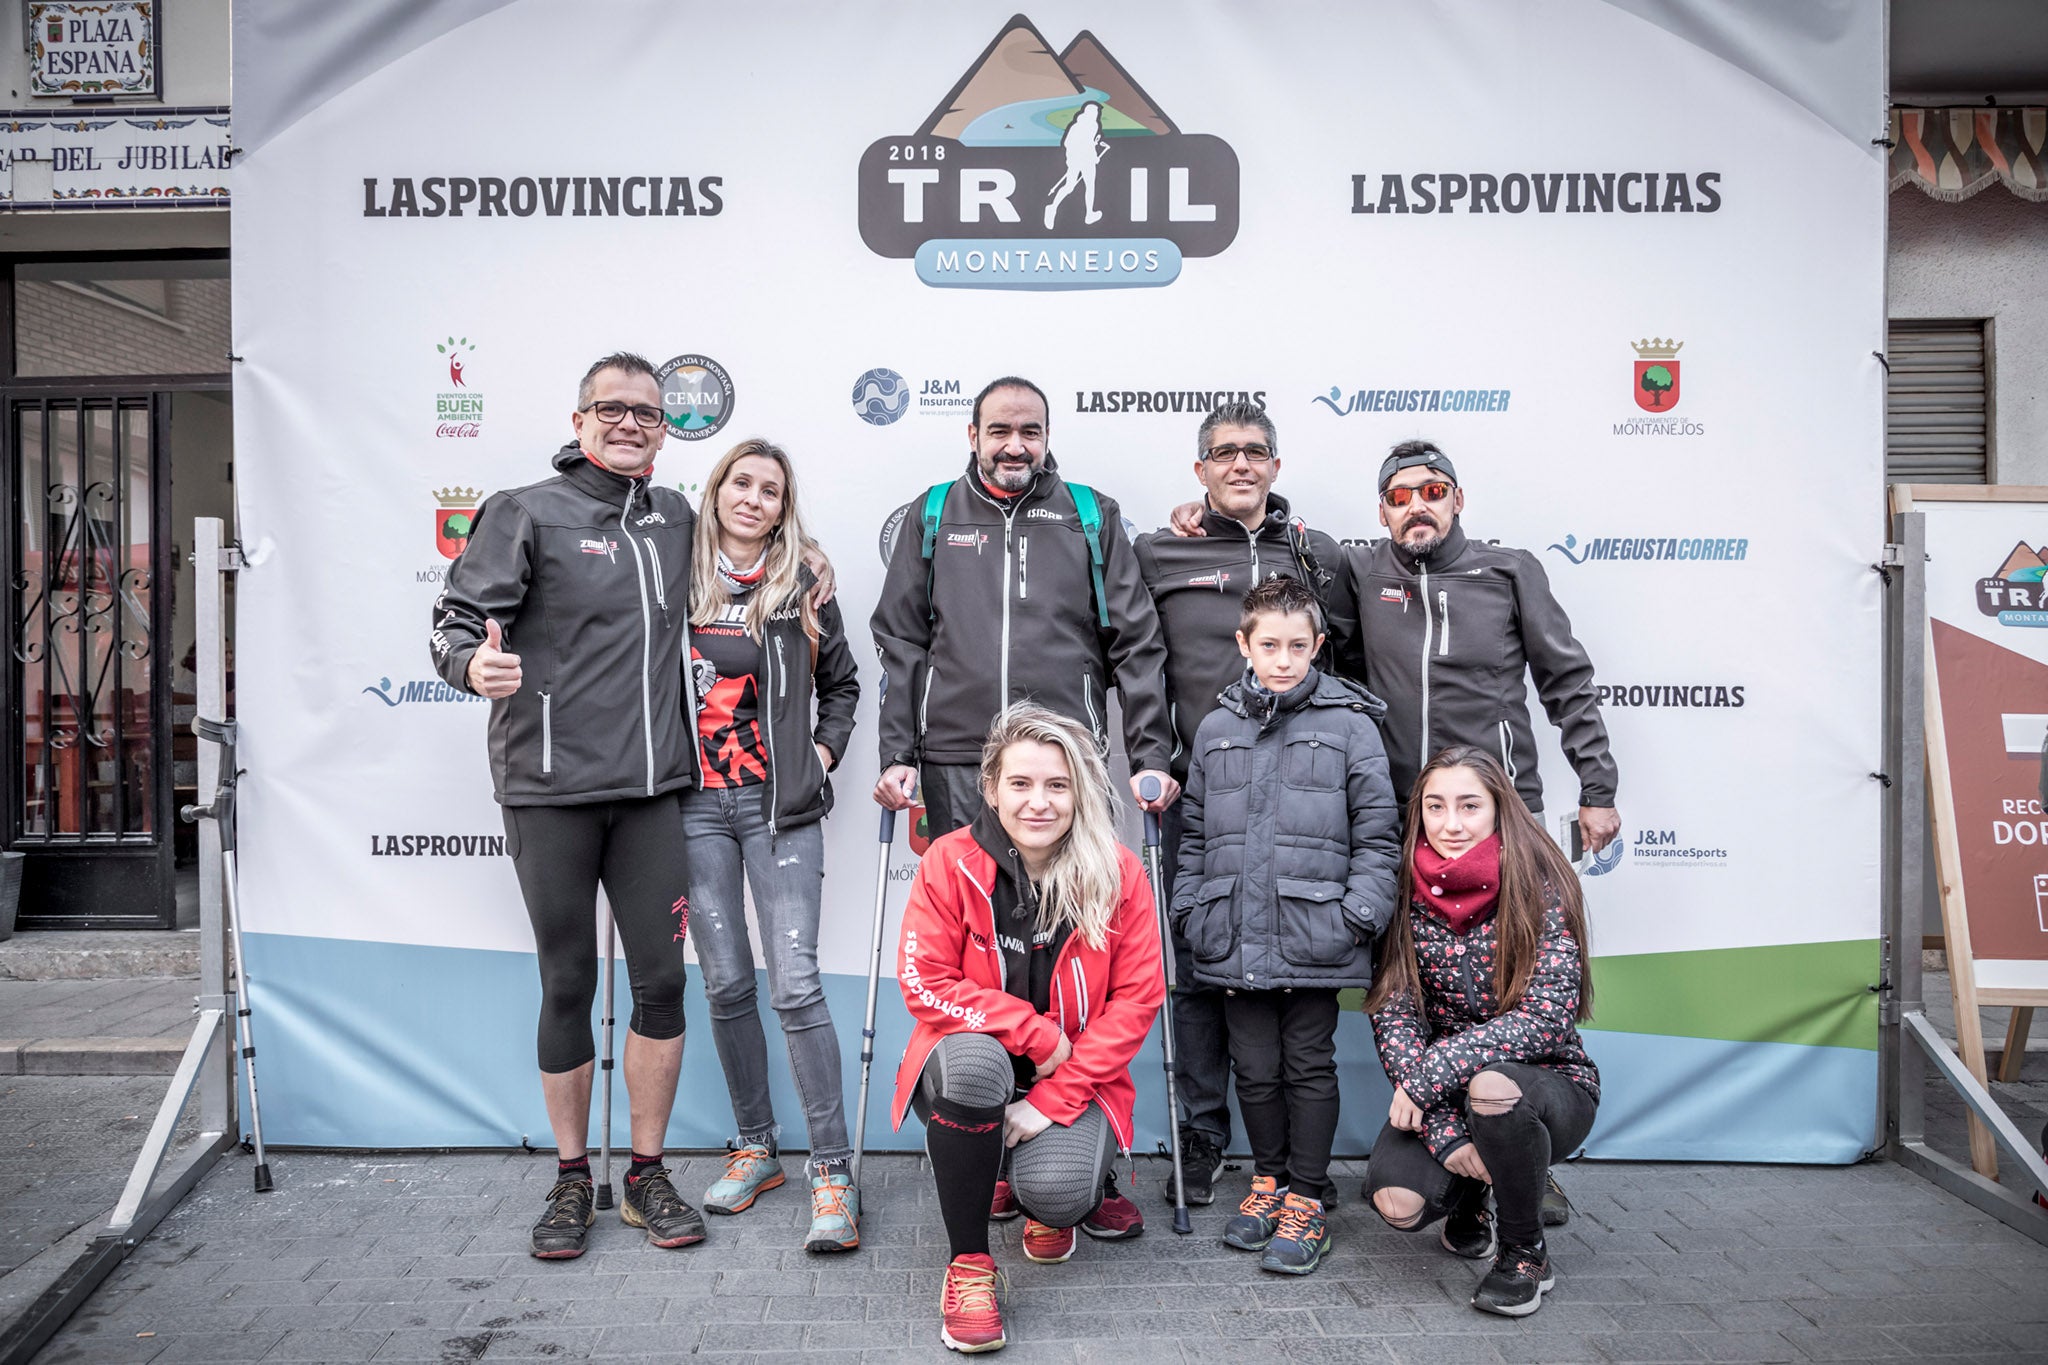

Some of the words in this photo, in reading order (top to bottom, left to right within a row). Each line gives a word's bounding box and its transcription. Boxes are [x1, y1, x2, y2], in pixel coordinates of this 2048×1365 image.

[69, 18, 134, 43] PLAZA
[47, 44, 136, 75] ESPAÑA
[52, 147, 102, 171] DEL
[118, 145, 231, 170] JUBILAD
[889, 145, 946, 161] 2018
[363, 176, 724, 218] LASPROVINCIAS
[1351, 172, 1722, 214] LASPROVINCIAS
[936, 250, 1160, 273] MONTANEJOS
[660, 357, 698, 378] ESCALADA
[699, 358, 707, 366] Y
[704, 361, 732, 397] MONTAÑA
[919, 379, 961, 395] J&M
[436, 399, 483, 413] BUEN
[664, 391, 719, 406] CEMM
[919, 397, 977, 407] Insurance
[1354, 389, 1511, 412] MEGUSTACORRER
[437, 413, 483, 421] AMBIENTE
[667, 423, 718, 439] MONTANEJOS
[1612, 423, 1705, 436] MONTANEJOS
[882, 521, 895, 543] CLUB
[1590, 538, 1749, 561] MEGUSTACORRER
[1596, 685, 1745, 708] PROVINCIAS
[2002, 799, 2045, 815] REC
[371, 835, 511, 857] LASPROVIN
[1633, 830, 1676, 846] J&M
[1634, 847, 1728, 859] InsuranceSports
[901, 930, 987, 1031] #somoscabras
